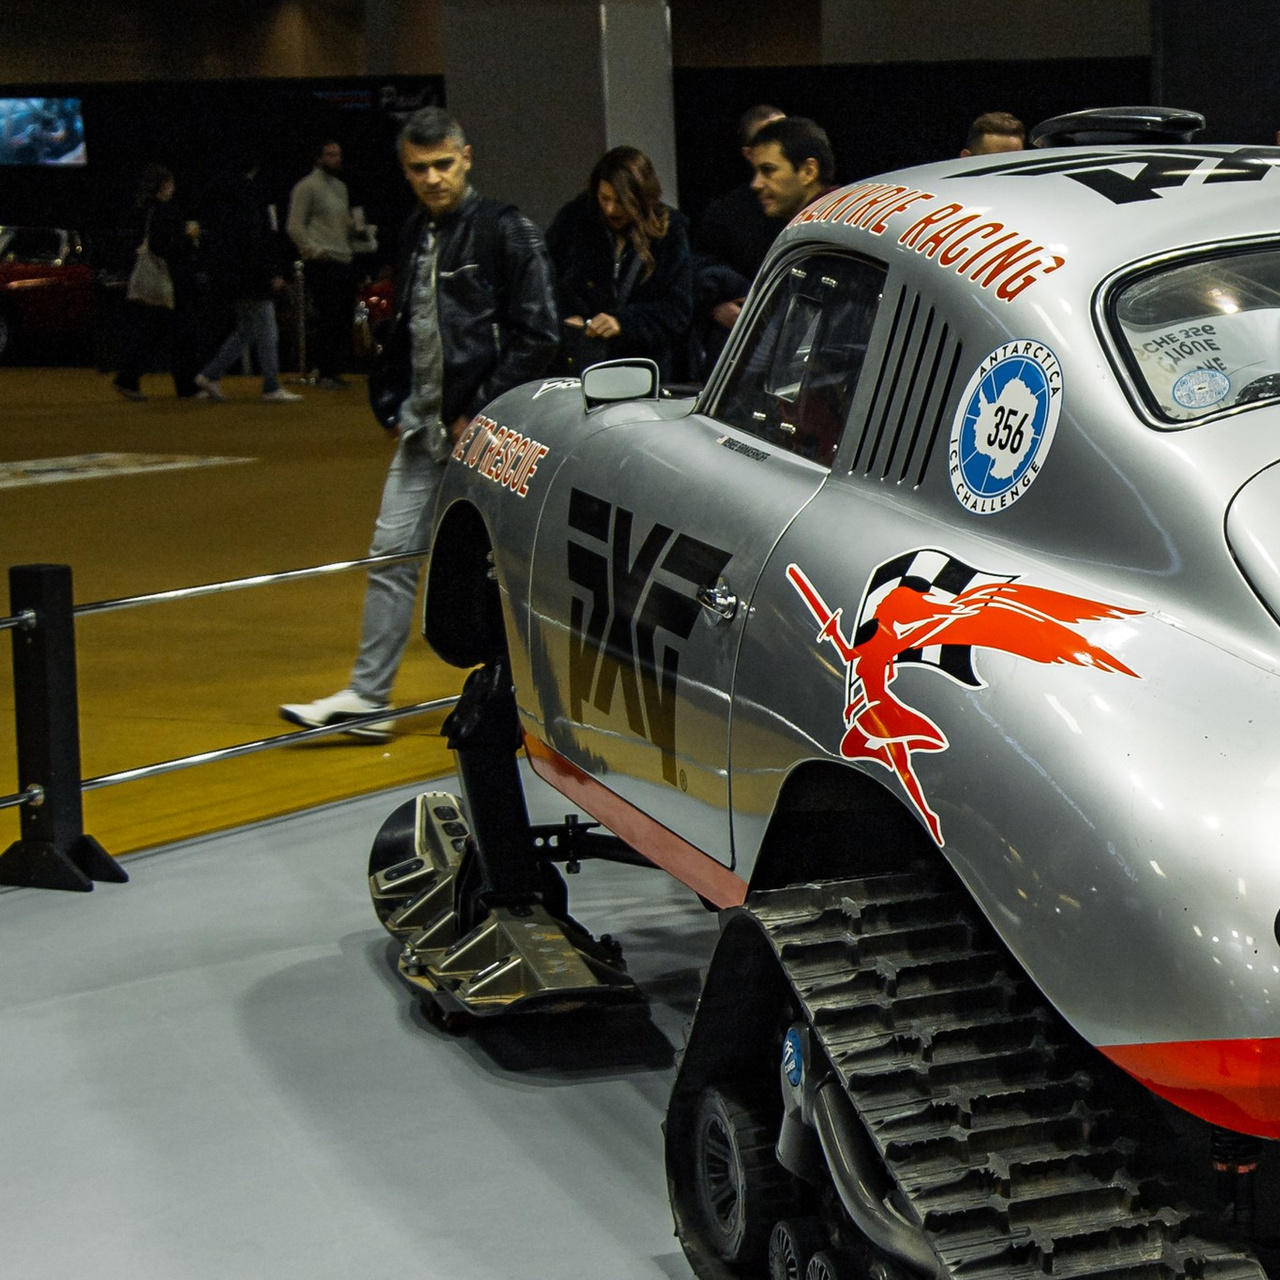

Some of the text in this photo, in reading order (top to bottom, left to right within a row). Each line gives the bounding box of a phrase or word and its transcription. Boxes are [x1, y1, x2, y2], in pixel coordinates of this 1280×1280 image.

[897, 201, 1066, 303] RACING
[979, 342, 1061, 399] ANTARCTICA
[477, 425, 550, 498] RESCUE
[986, 404, 1030, 455] 356
[949, 439, 1040, 513] ICE CHALLENGE
